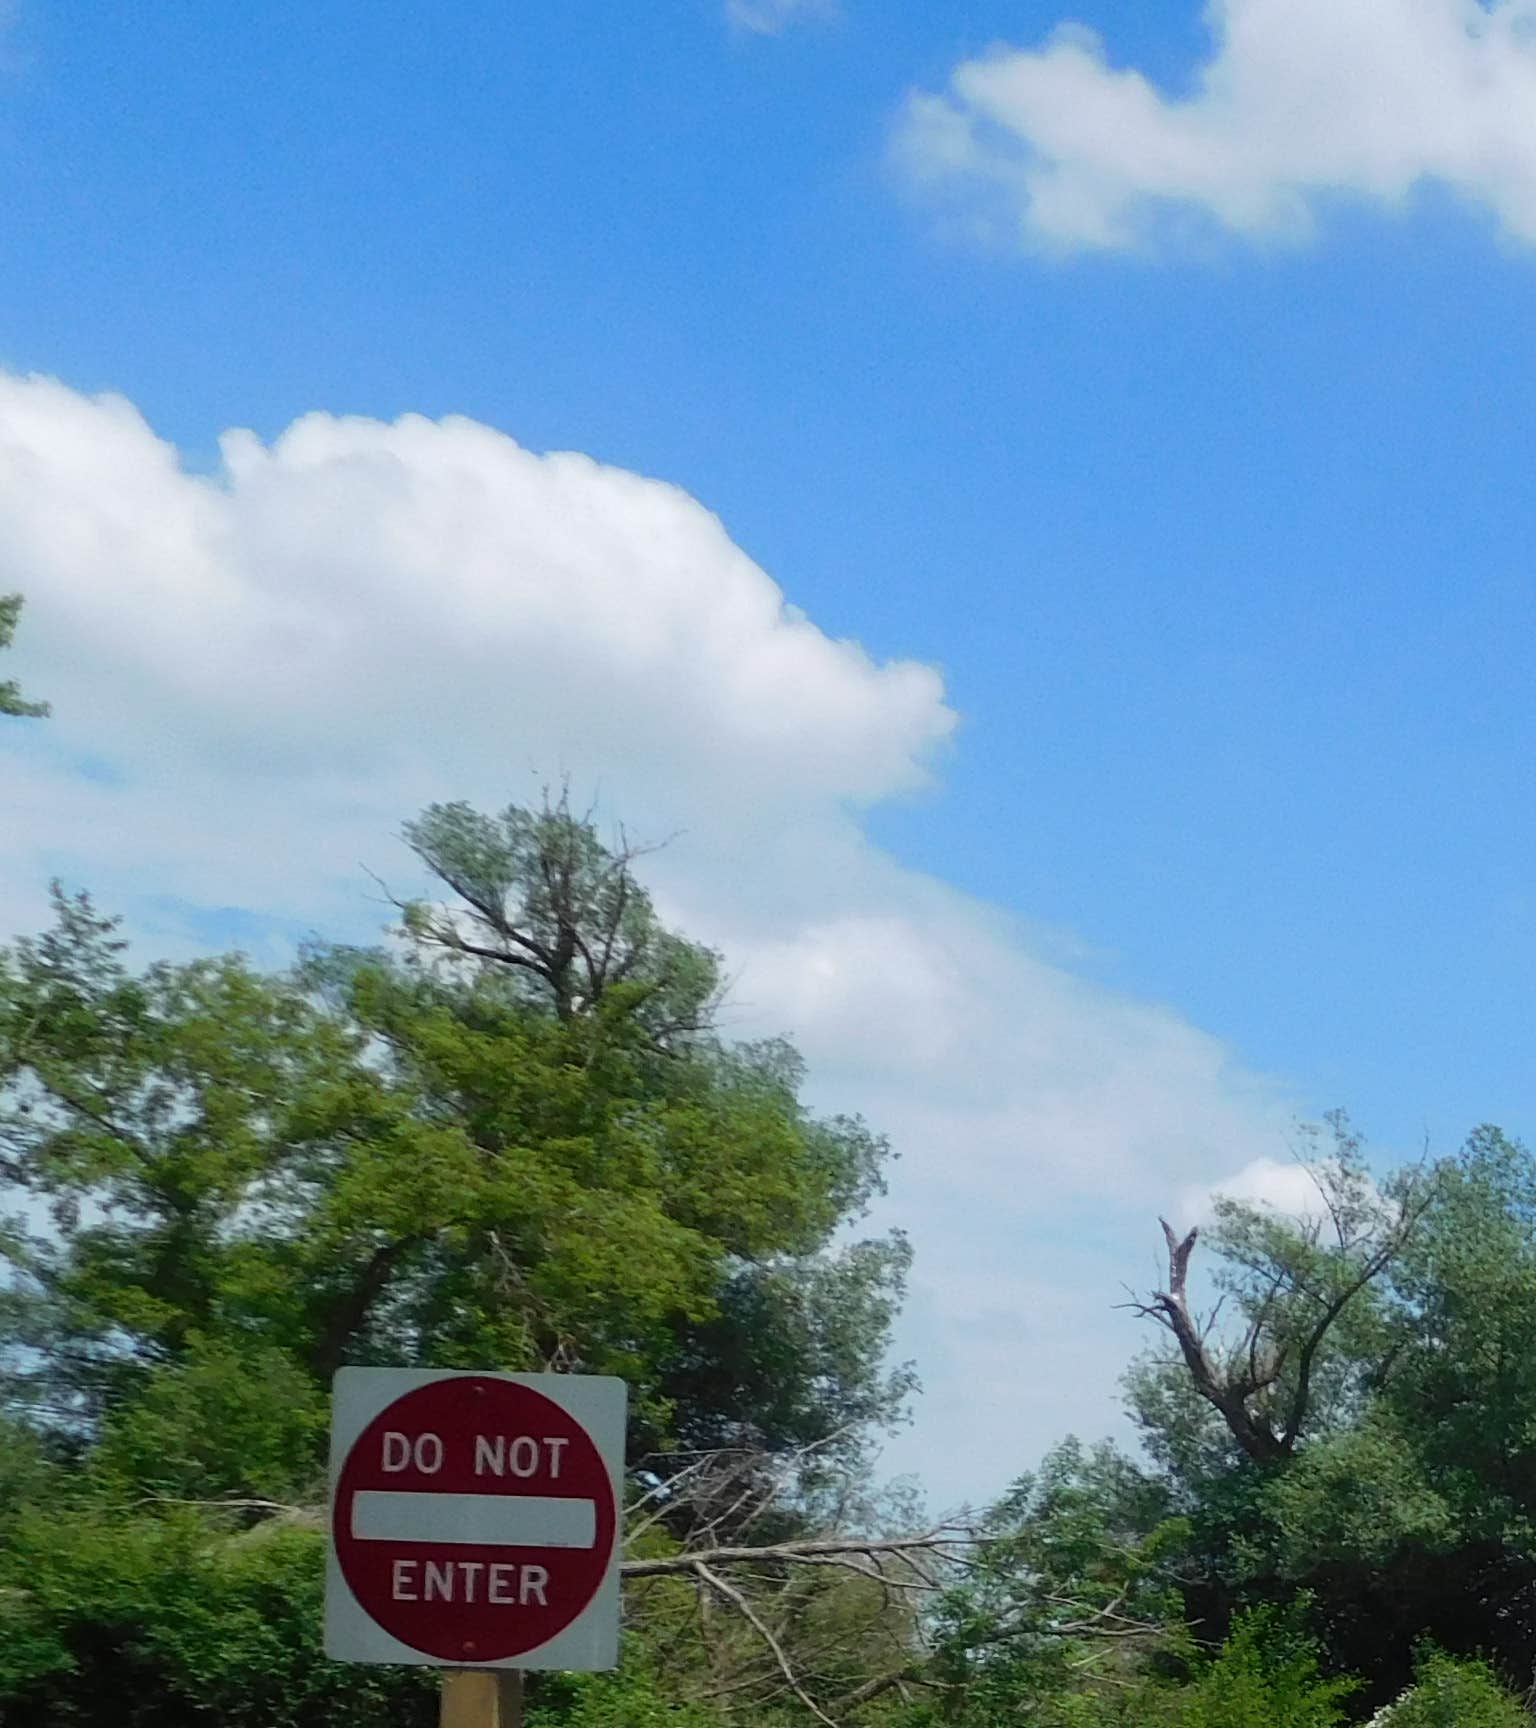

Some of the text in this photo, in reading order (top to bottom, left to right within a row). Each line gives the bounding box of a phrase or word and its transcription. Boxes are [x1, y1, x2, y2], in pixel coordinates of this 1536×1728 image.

[381, 1431, 569, 1479] DO NOT
[392, 1560, 549, 1606] ENTER
